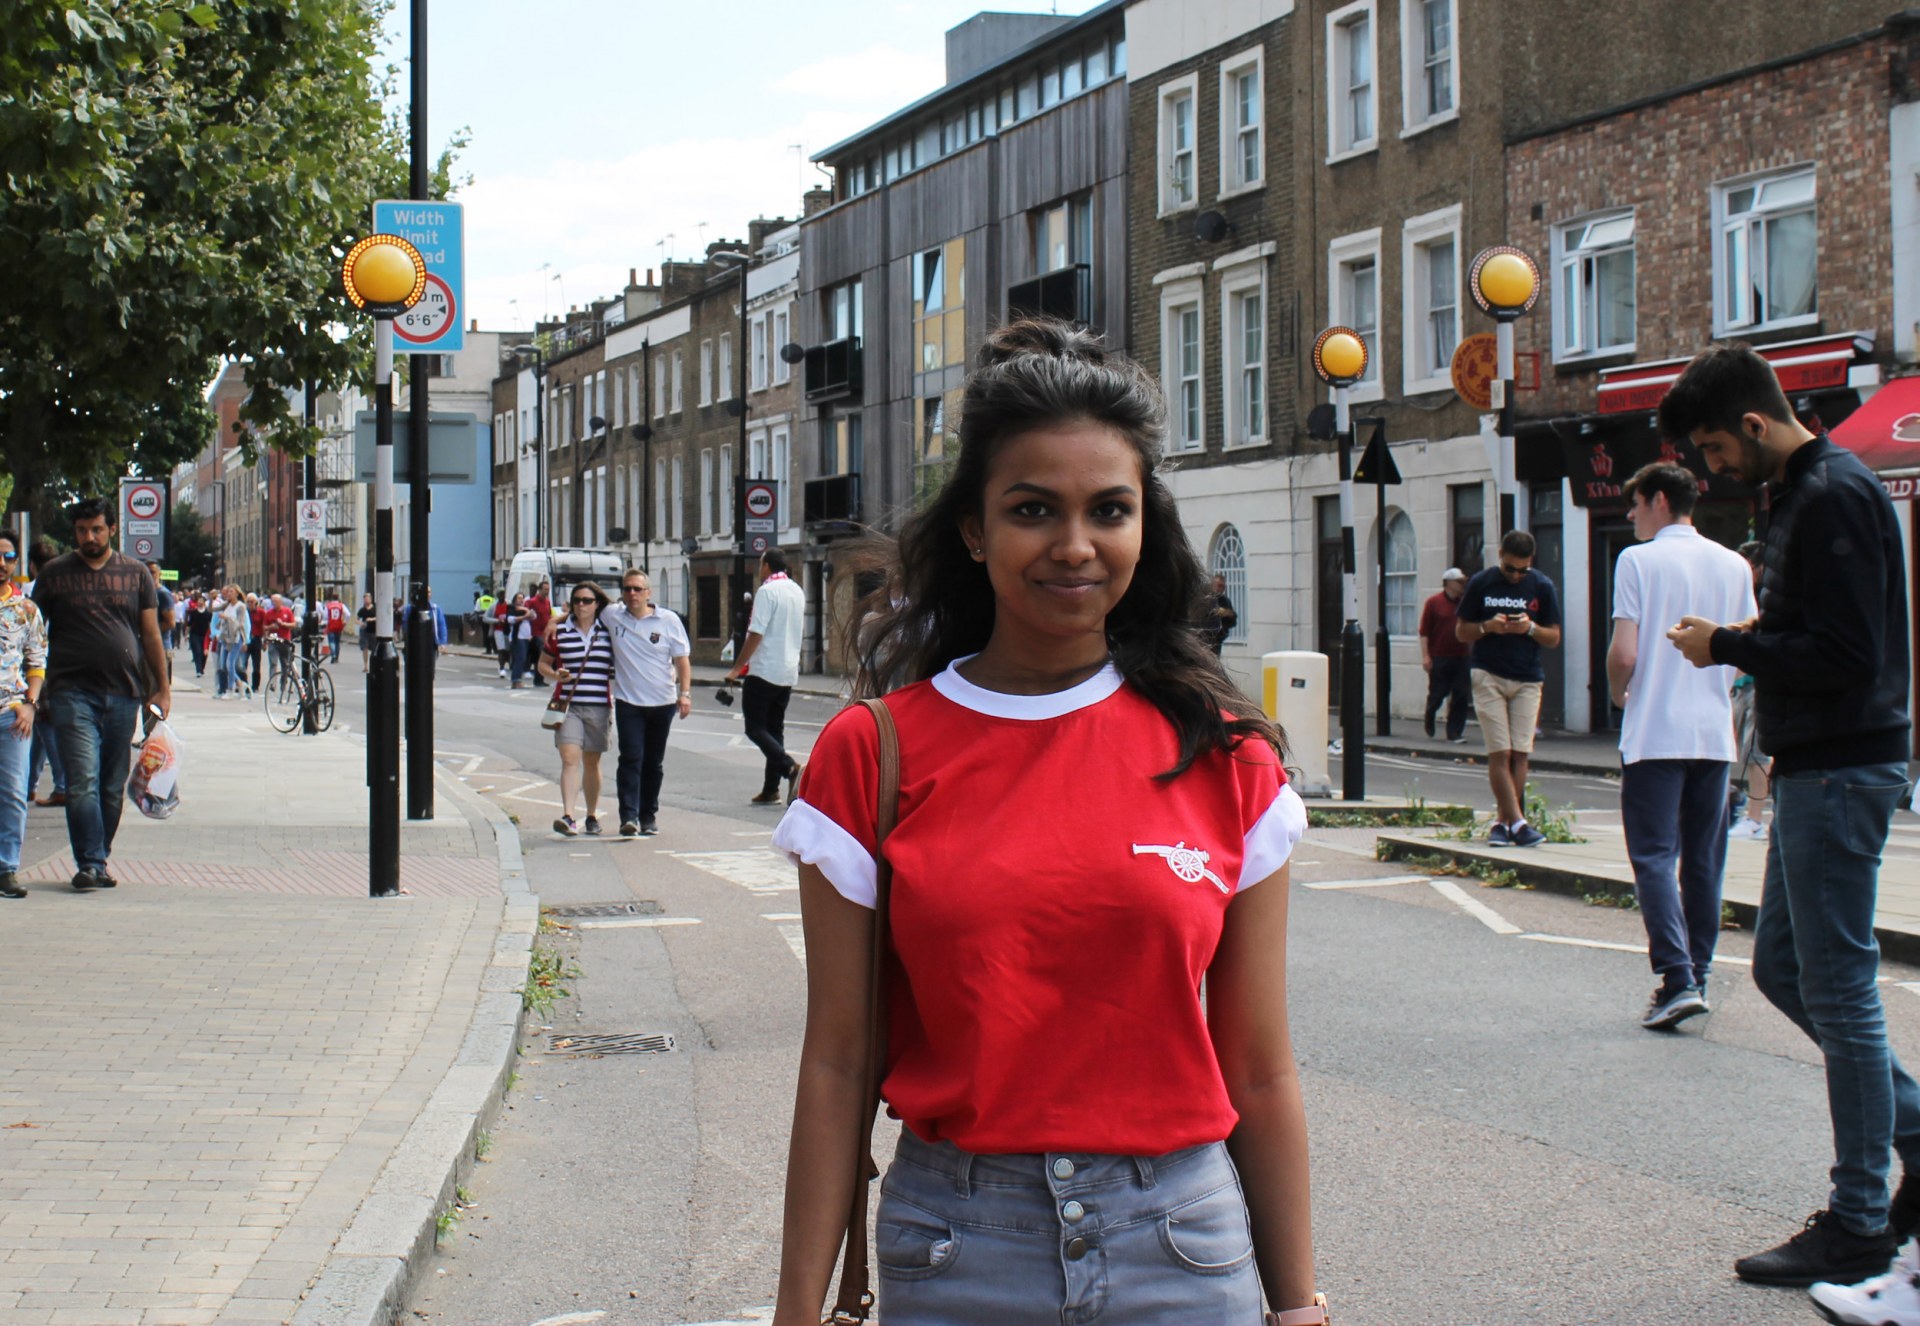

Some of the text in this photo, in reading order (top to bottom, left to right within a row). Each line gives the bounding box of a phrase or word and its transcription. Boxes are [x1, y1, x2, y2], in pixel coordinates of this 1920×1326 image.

[394, 210, 444, 226] Width
[400, 229, 438, 245] limit
[421, 248, 445, 263] ad
[1484, 596, 1527, 609] Reebok
[331, 608, 340, 620] 19
